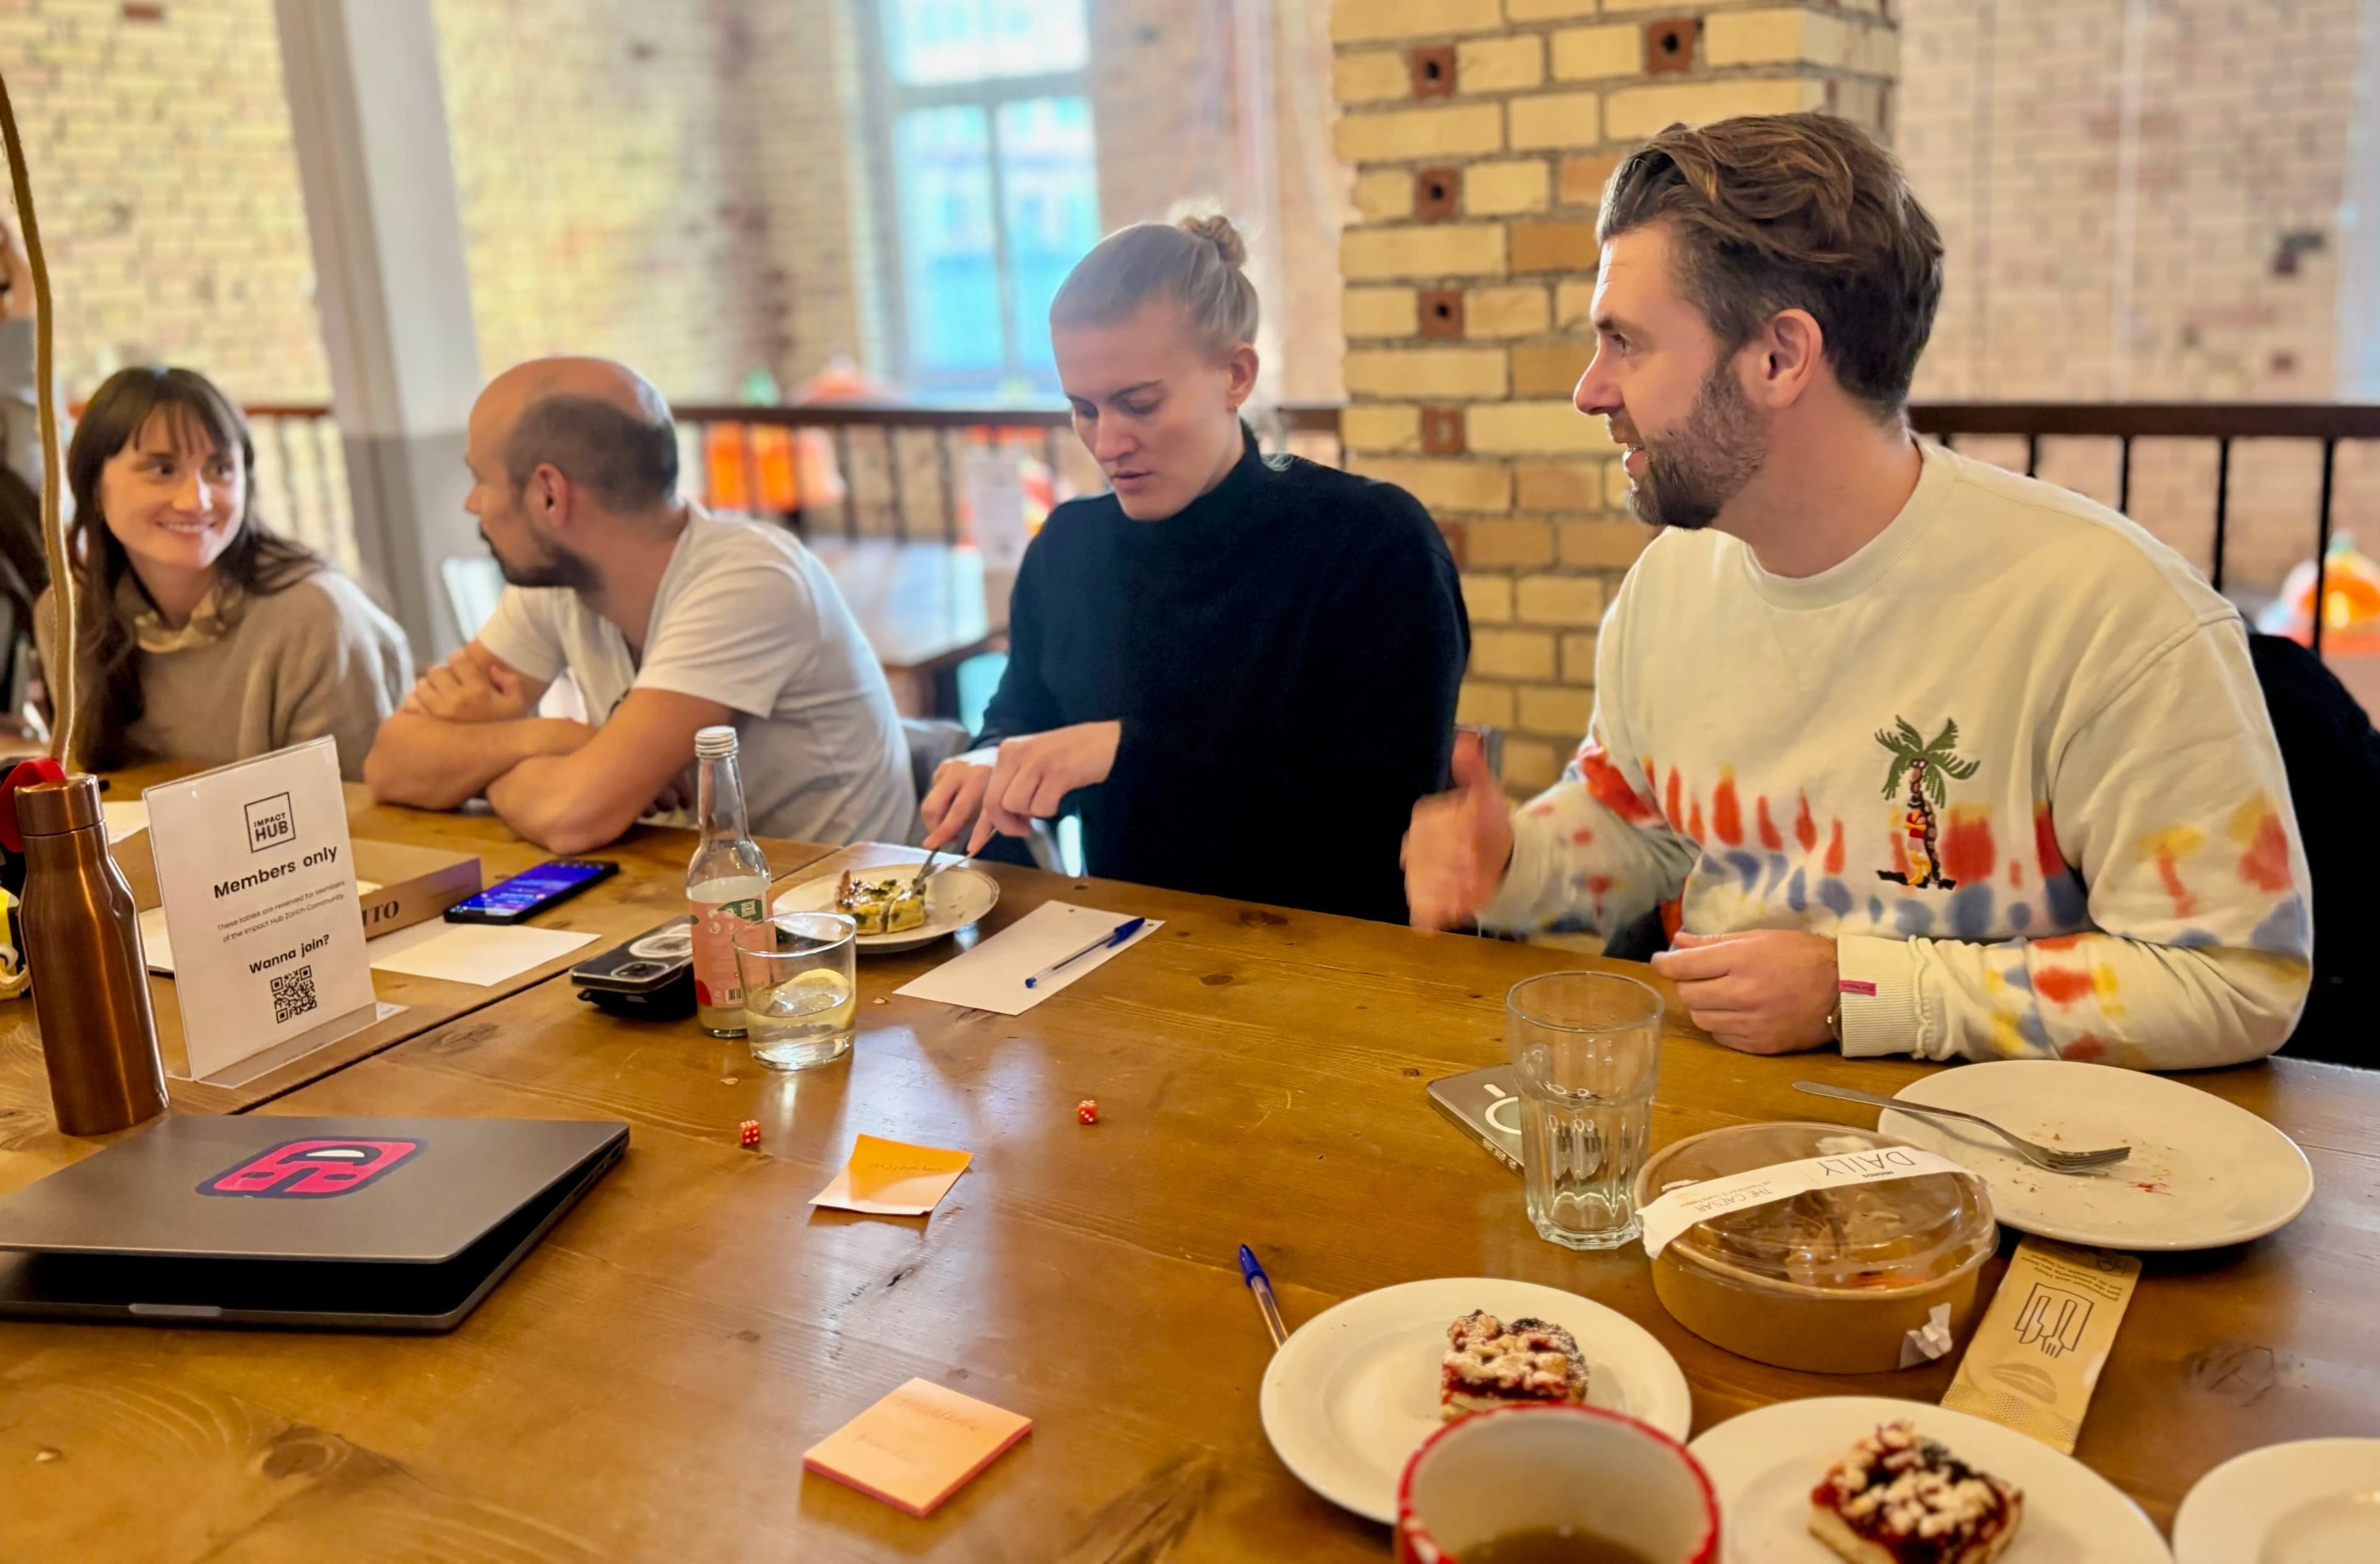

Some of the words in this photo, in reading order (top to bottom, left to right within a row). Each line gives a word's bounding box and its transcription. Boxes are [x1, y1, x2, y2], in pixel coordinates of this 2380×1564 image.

[253, 812, 286, 828] IMPACT
[255, 820, 289, 842] HUB
[213, 861, 296, 898] Members
[302, 846, 337, 867] only
[218, 920, 239, 930] These
[239, 911, 261, 923] tables
[262, 907, 274, 915] are
[275, 895, 304, 909] reserved
[315, 880, 345, 895] Members
[231, 931, 244, 939] the
[270, 916, 284, 924] Hub
[249, 949, 296, 974] Wanna
[301, 934, 330, 958] join?
[1817, 1151, 1916, 1177] DAILY
[1694, 1193, 1747, 1212] CAESAR
[1750, 1187, 1774, 1198] THE
